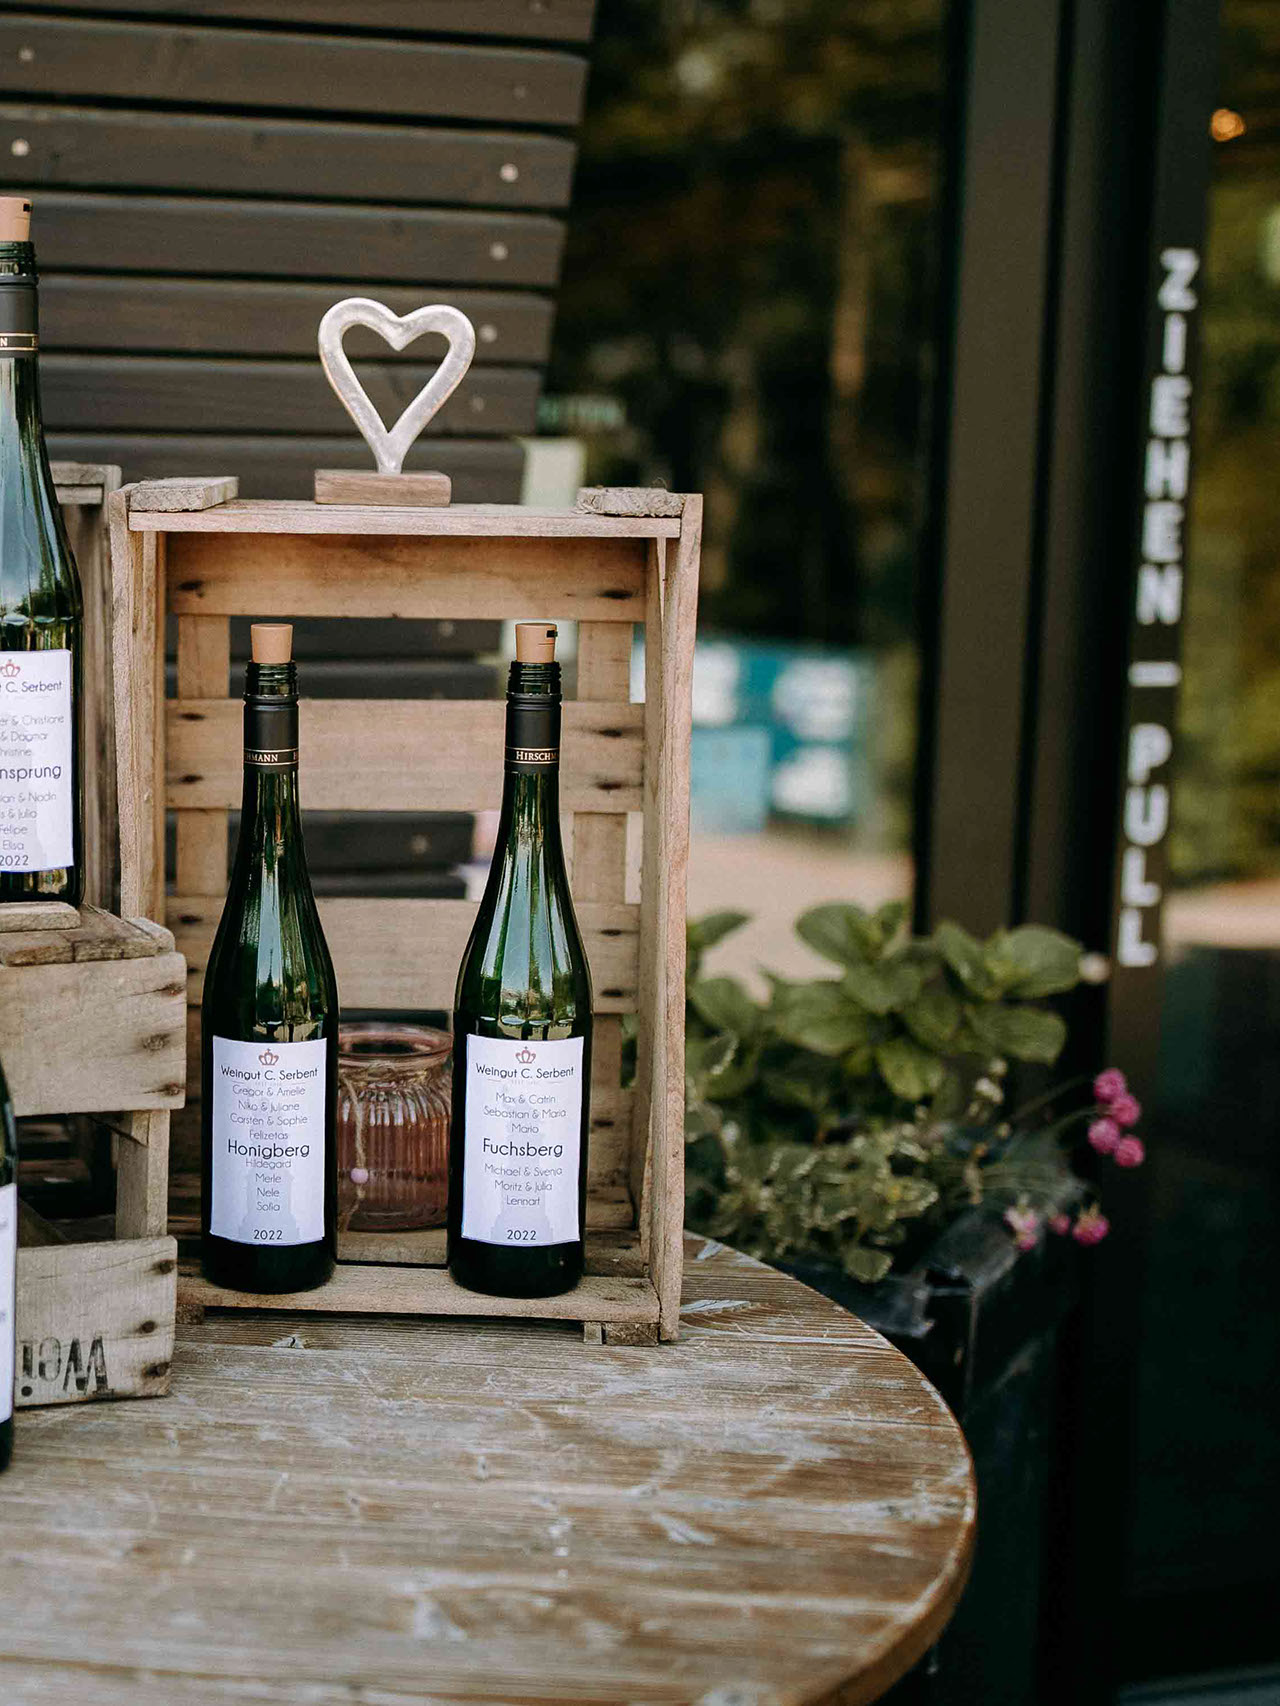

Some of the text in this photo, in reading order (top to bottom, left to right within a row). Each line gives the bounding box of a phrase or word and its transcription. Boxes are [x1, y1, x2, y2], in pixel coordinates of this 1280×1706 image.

[1135, 246, 1200, 626] ZIEHEN
[21, 680, 63, 693] Serbent
[1116, 723, 1173, 968] PULL
[221, 1065, 318, 1081] Weingut C. Serbent
[476, 1063, 574, 1079] Weingut C. Serbent
[267, 1087, 273, 1096] &
[496, 1092, 515, 1104] Max
[519, 1094, 525, 1103] &
[239, 1100, 258, 1111] Niko
[261, 1102, 268, 1111] &
[484, 1105, 529, 1118] Sebastian
[532, 1109, 539, 1119] &
[267, 1116, 274, 1126] &
[228, 1138, 310, 1160] Honigberg
[483, 1138, 563, 1157] Fuchsberg
[524, 1167, 530, 1176] &
[255, 1173, 282, 1183] Merle
[495, 1180, 522, 1191] Moritz
[525, 1182, 532, 1191] &
[256, 1187, 280, 1197] Nele
[256, 1202, 281, 1211] Sofia
[253, 1229, 283, 1240] 2022
[507, 1229, 537, 1240] 2022
